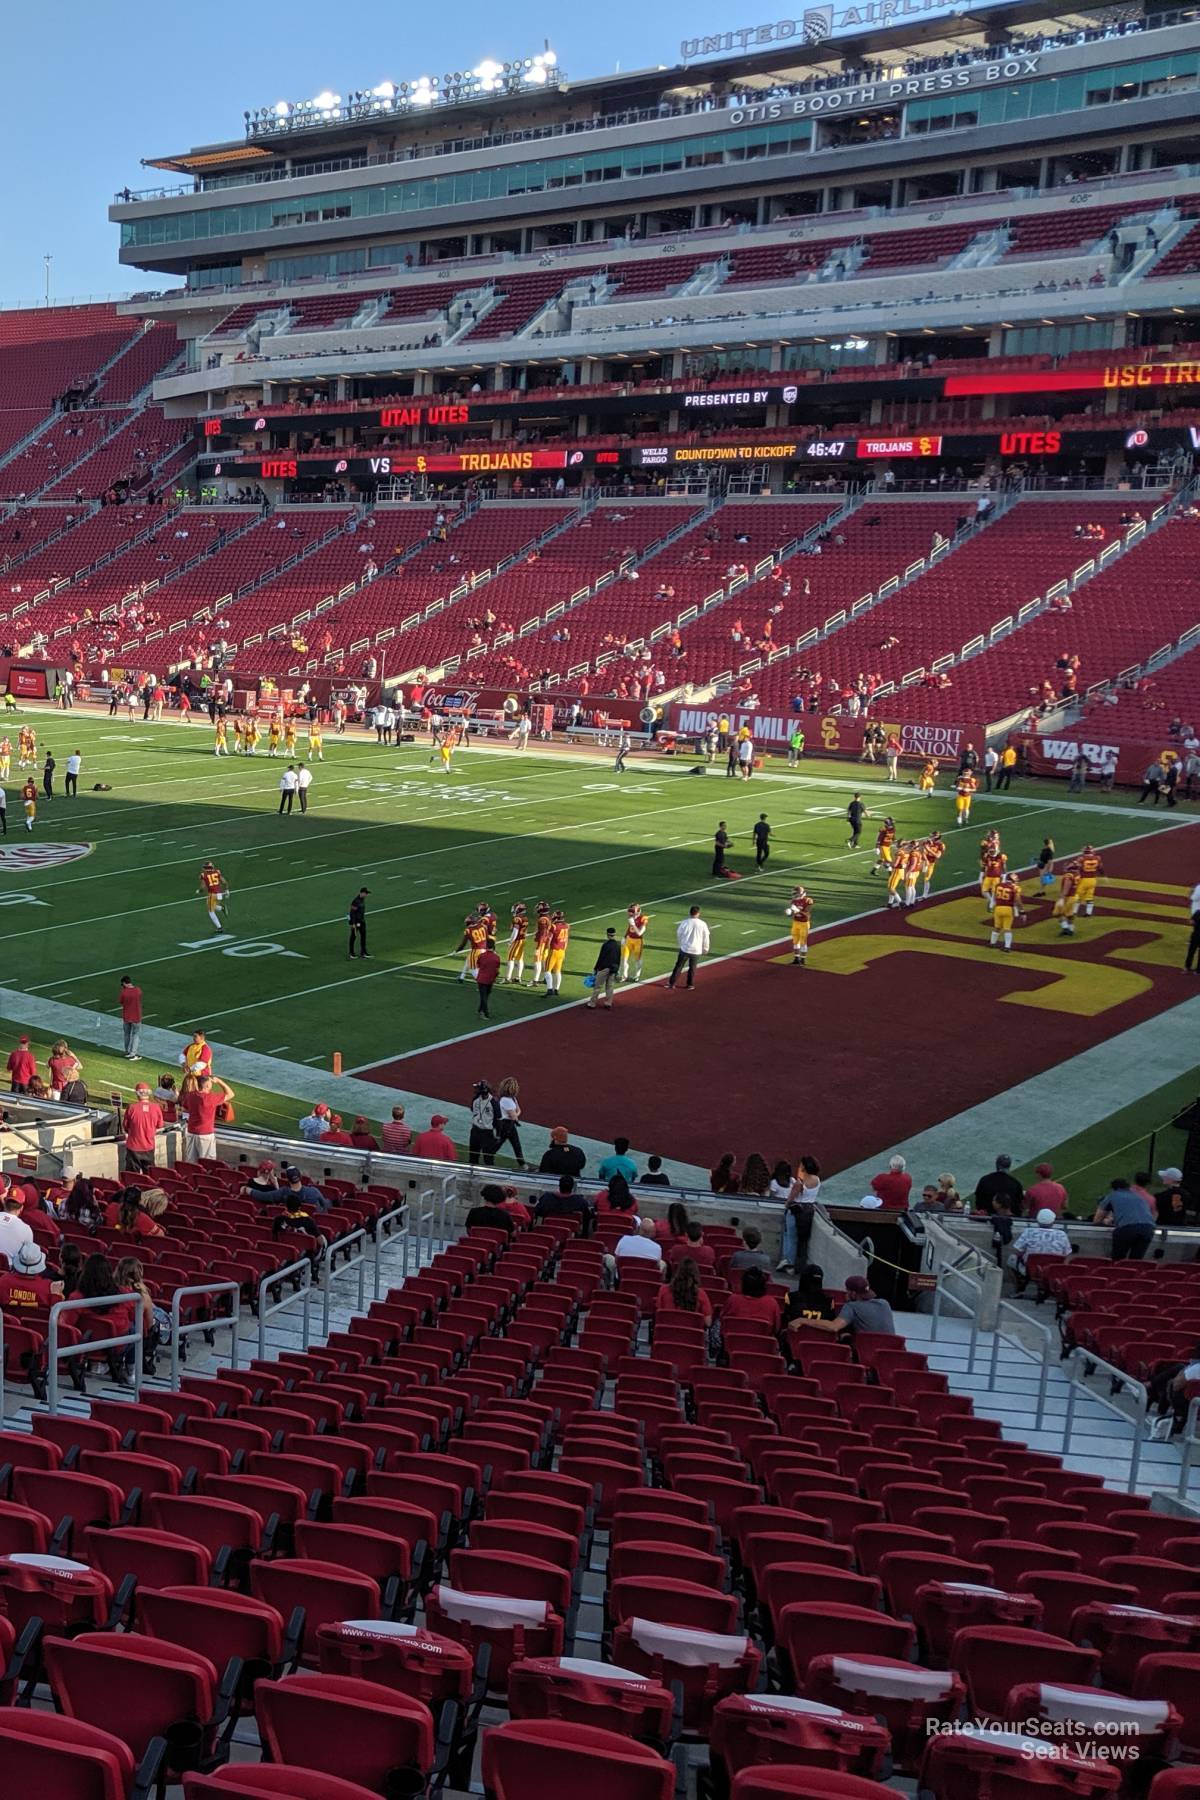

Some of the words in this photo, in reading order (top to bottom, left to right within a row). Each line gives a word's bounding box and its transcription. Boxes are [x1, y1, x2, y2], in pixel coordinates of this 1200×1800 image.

[680, 20, 796, 58] UNITED
[730, 105, 781, 125] OTIS
[793, 88, 875, 115] BOOTH
[890, 71, 970, 97] PRESS
[987, 57, 1040, 81] BOX
[1103, 364, 1153, 388] USC
[685, 392, 751, 407] PRESENTED
[754, 391, 768, 404] BY
[381, 407, 421, 427] UTAH
[428, 405, 469, 424] UTES
[205, 420, 221, 437] UTES
[642, 447, 668, 456] WELLS
[807, 441, 845, 457] 46:47
[866, 441, 913, 454] TROJANS
[1000, 432, 1061, 455] UTES
[642, 456, 667, 464] FARGO
[675, 447, 737, 461] COUNTDOWN
[740, 447, 752, 459] TO
[754, 445, 797, 458] KICKOFF
[261, 461, 297, 478] UTES
[370, 457, 391, 474] VS
[459, 452, 533, 471] TROJANS
[754, 715, 801, 741] MILK
[901, 725, 964, 744] CREDIT
[902, 740, 960, 757] UNION
[207, 873, 219, 887] 15
[178, 934, 286, 958] 10
[9, 1288, 37, 1301] LONDON
